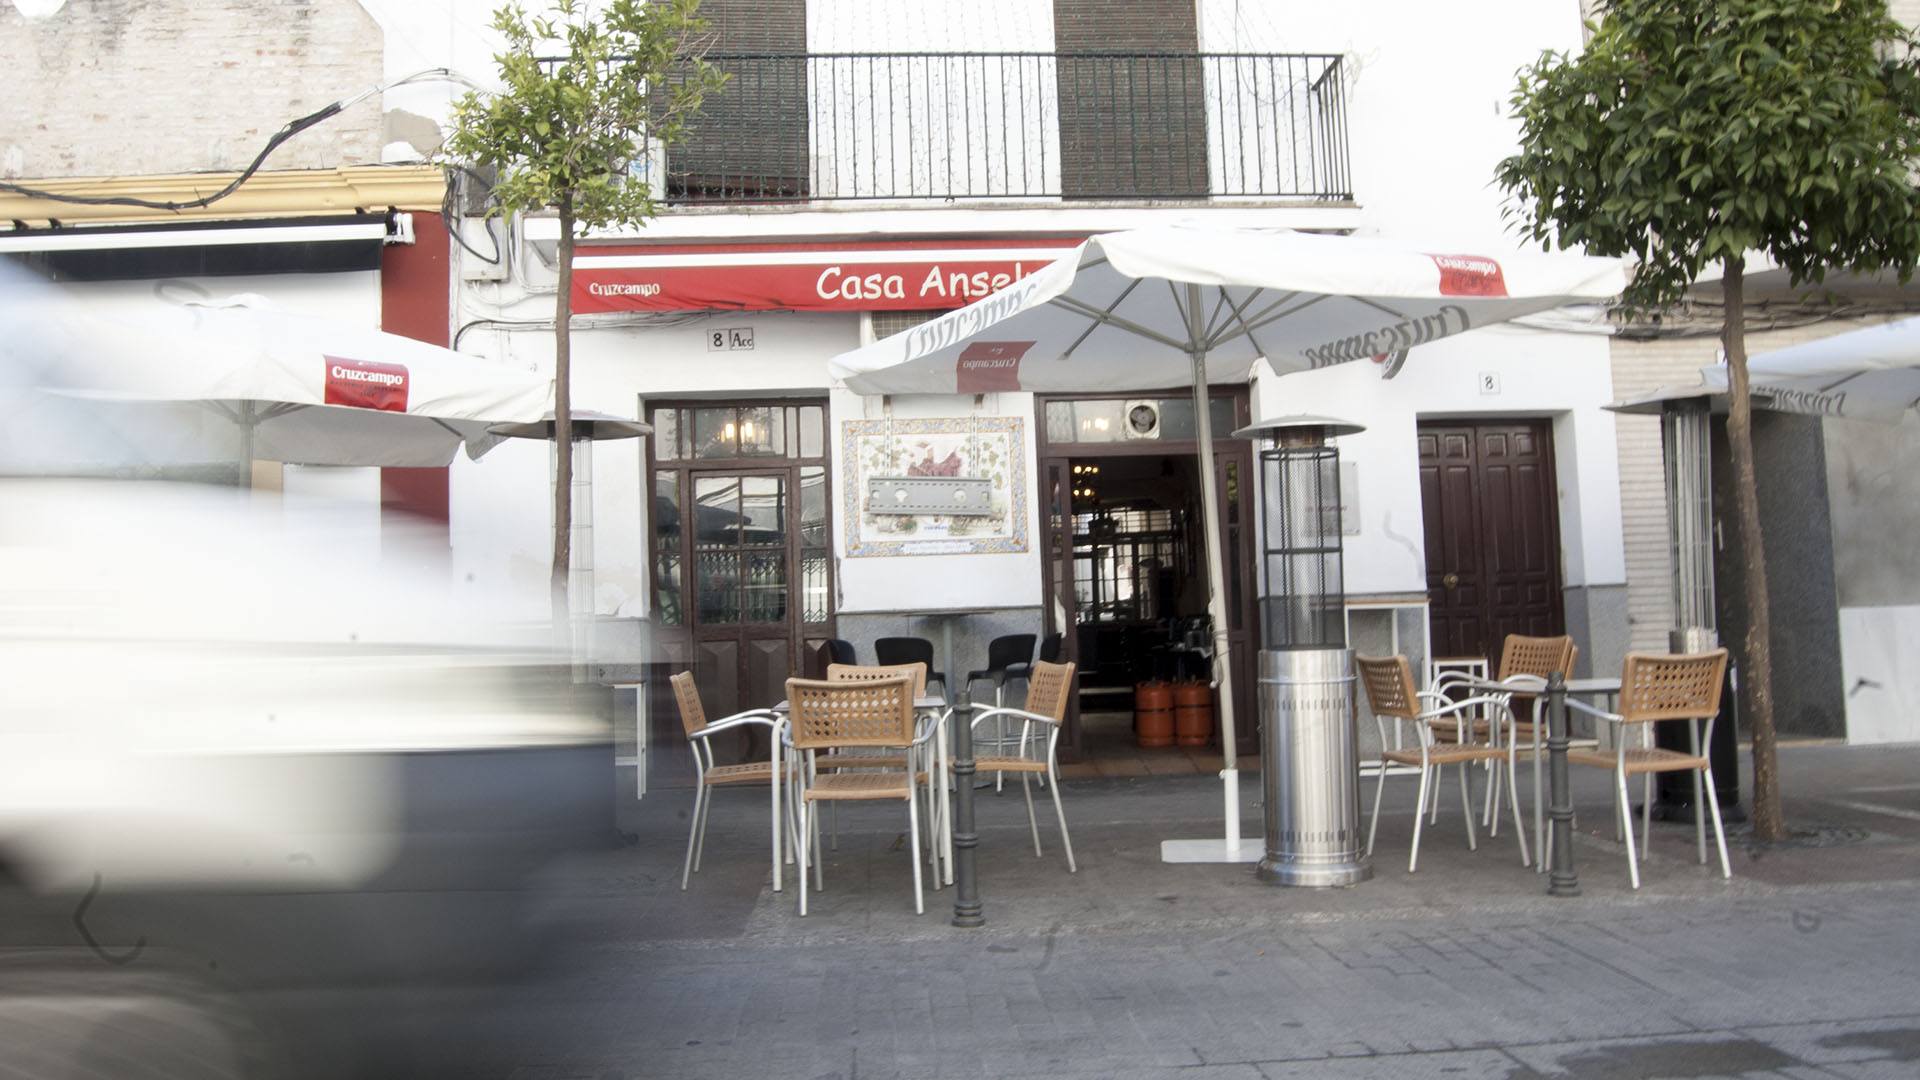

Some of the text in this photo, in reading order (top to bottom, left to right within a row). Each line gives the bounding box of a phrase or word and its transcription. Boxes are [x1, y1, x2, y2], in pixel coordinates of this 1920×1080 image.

[816, 261, 1031, 300] Casa Ansel
[589, 282, 660, 297] Cruzcampo
[713, 332, 723, 347] 8
[331, 365, 404, 386] Cruzcampo
[1485, 375, 1494, 390] 8
